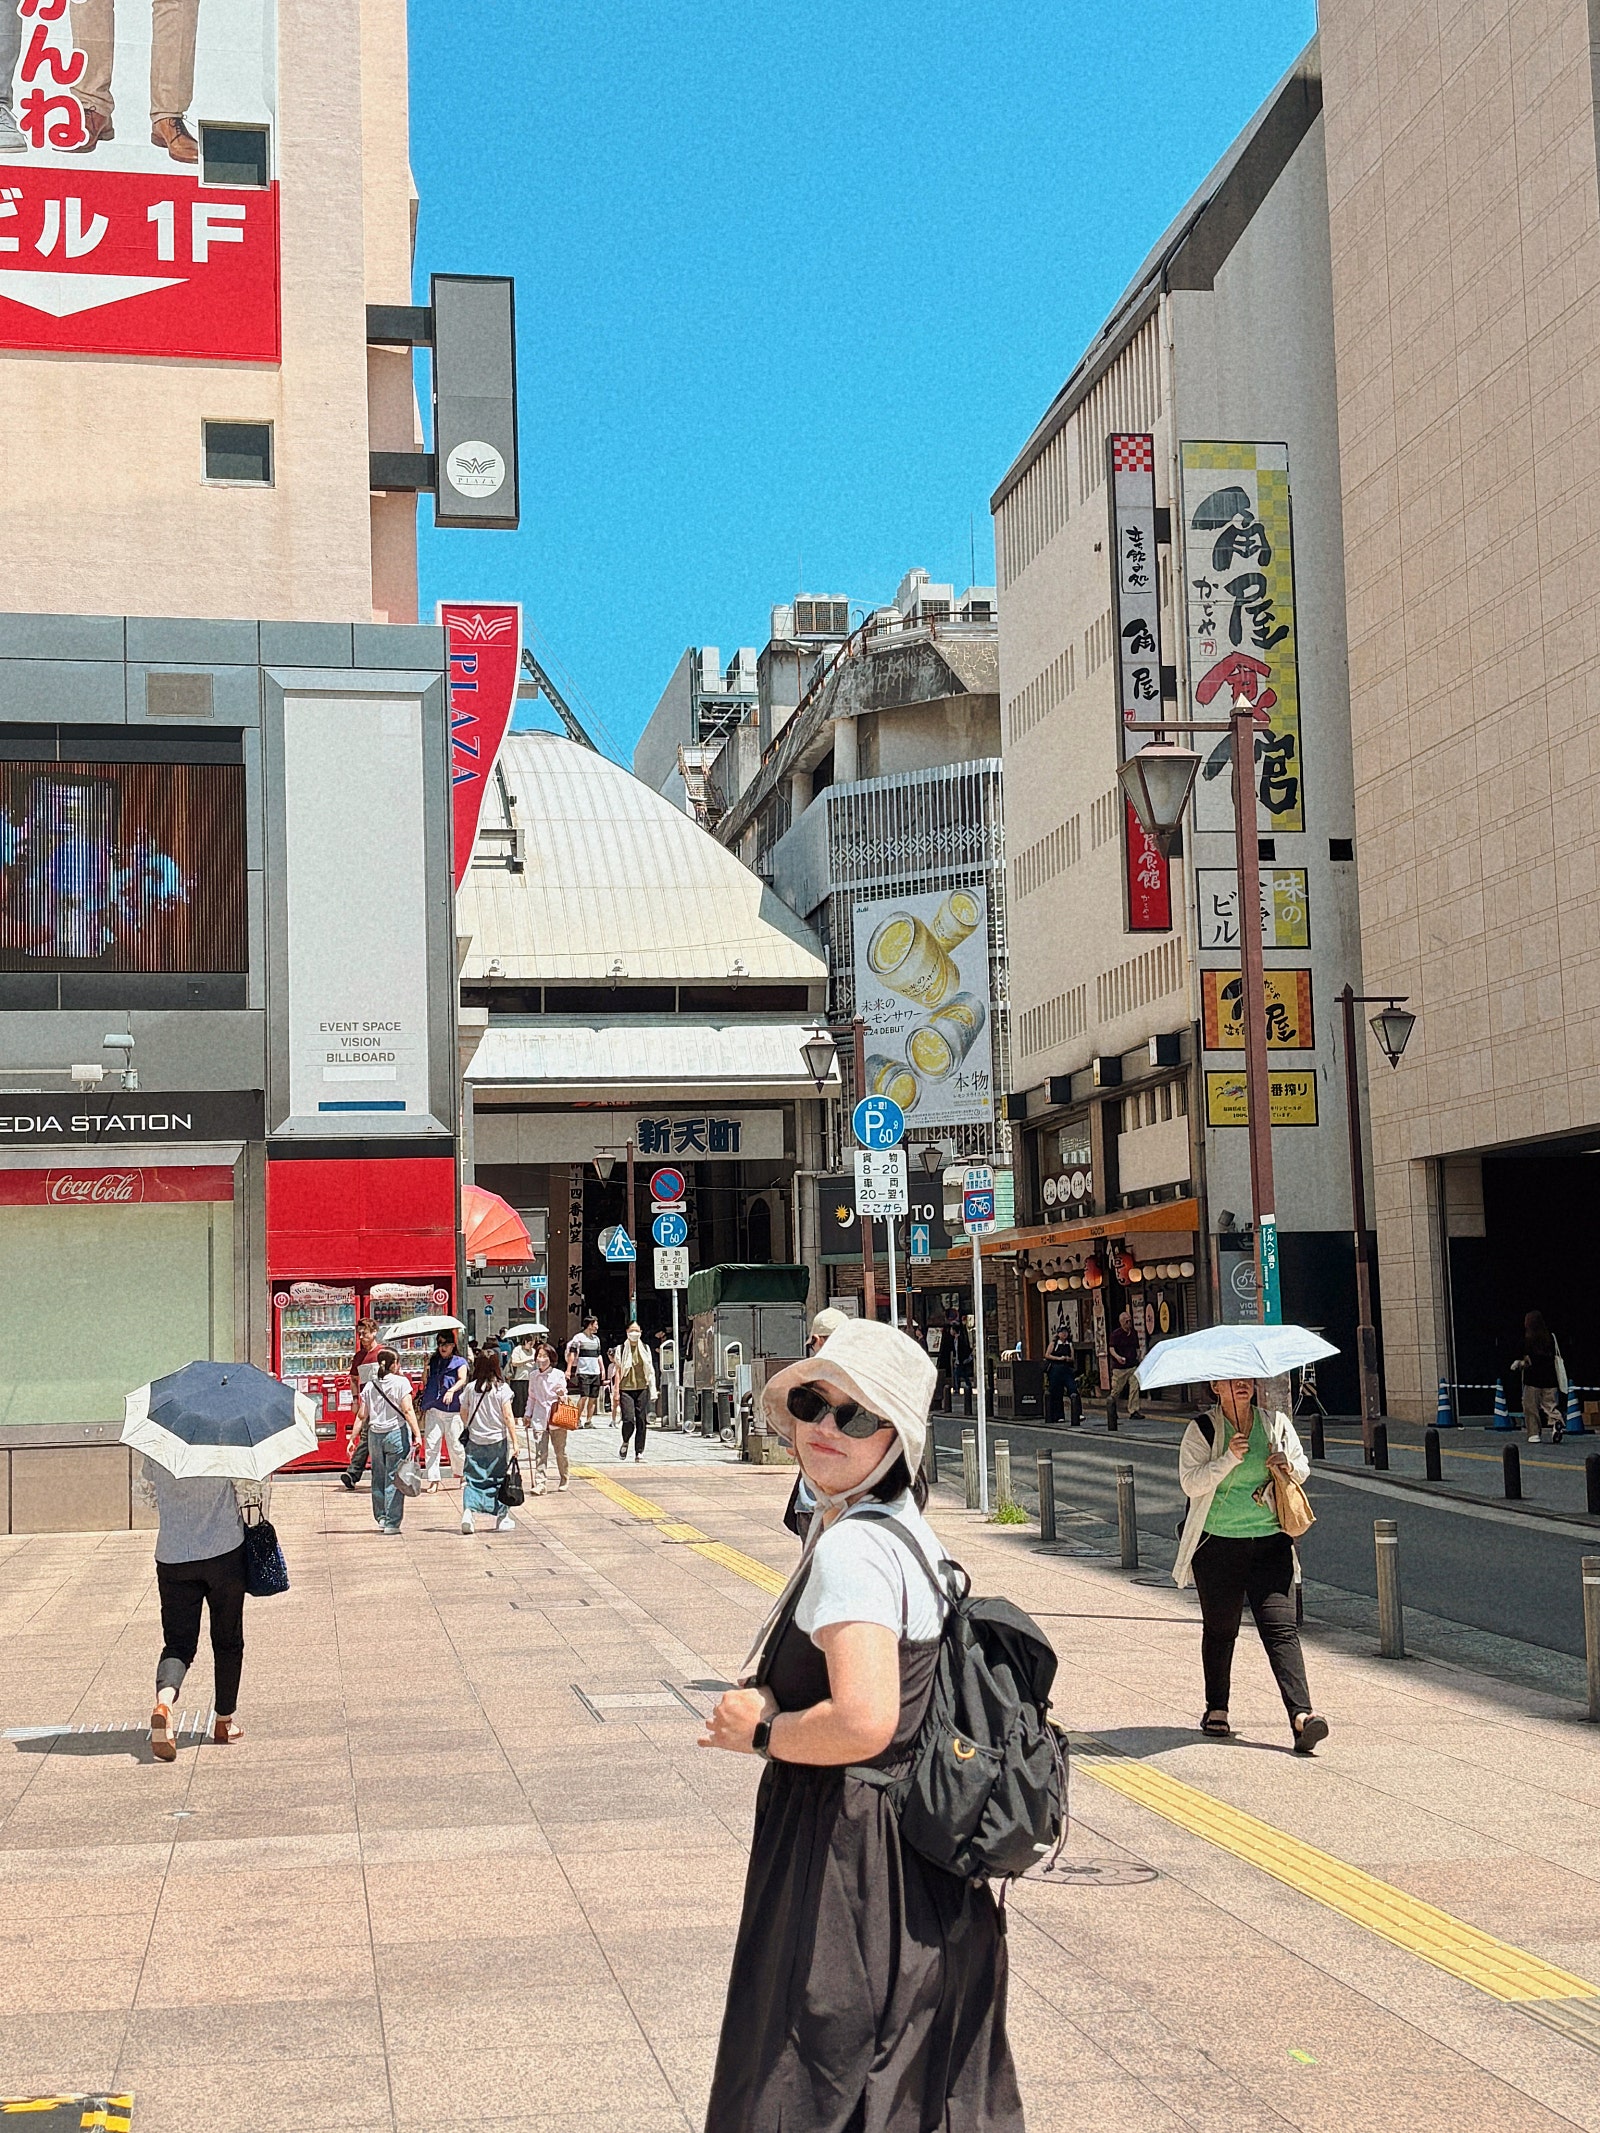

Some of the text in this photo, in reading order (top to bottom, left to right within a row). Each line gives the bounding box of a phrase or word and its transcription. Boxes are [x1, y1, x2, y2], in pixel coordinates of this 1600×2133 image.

[147, 200, 246, 263] 1F
[450, 652, 480, 788] PLAZA
[1272, 873, 1309, 924] 味の
[1213, 891, 1239, 943] ビル
[861, 998, 896, 1013] 未来の
[862, 1009, 923, 1024] レモンサワー
[319, 1021, 402, 1032] EVENT SPACE
[880, 1026, 905, 1034] DEBUT
[341, 1037, 381, 1047] VISION
[326, 1052, 396, 1063] BILLBOARD
[953, 1070, 989, 1092] 本物
[71, 1114, 193, 1132] STATION
[864, 1110, 885, 1144] P
[637, 1118, 742, 1154] 新天町
[879, 1128, 894, 1144] 60
[862, 1164, 899, 1175] 8-20
[52, 1174, 138, 1201] Coca-Cola
[862, 1203, 902, 1213] ここから
[499, 1265, 530, 1273] PLAZA
[567, 1264, 583, 1316] 新天町
